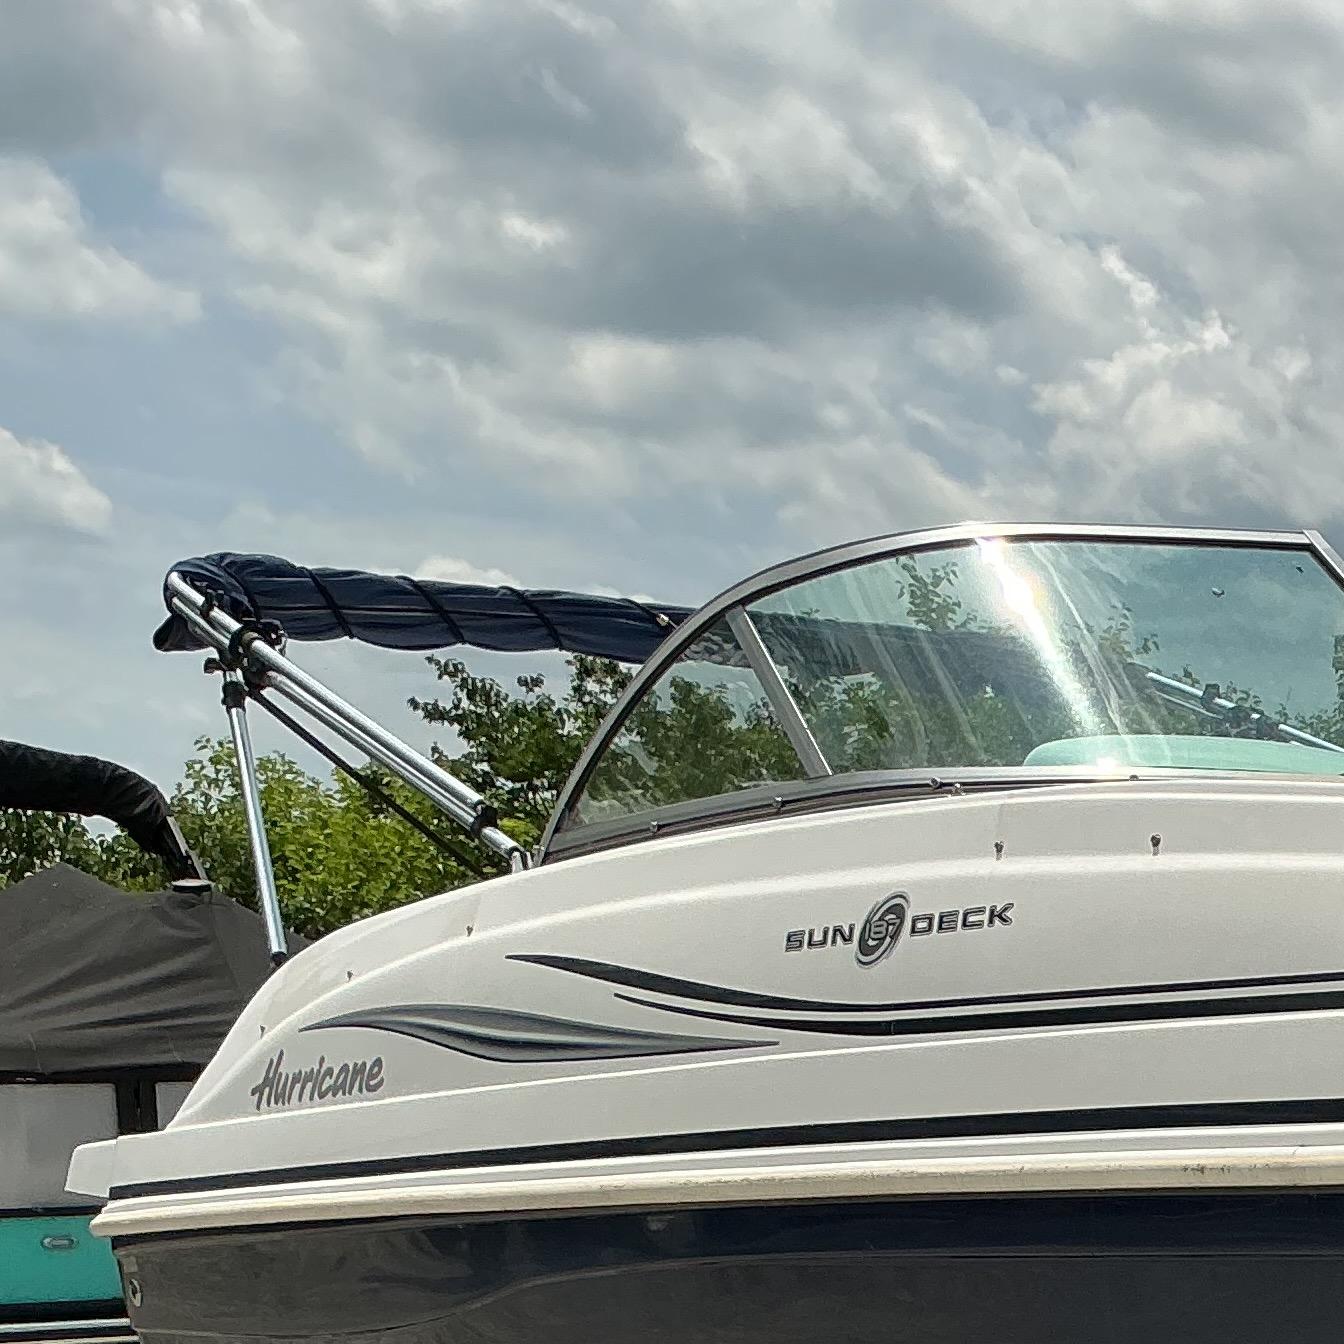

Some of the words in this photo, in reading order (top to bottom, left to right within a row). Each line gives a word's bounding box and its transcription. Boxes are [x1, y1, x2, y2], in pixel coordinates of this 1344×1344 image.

[785, 923, 856, 952] SUN
[865, 915, 902, 941] 187
[910, 903, 1015, 937] DECK
[250, 1048, 385, 1112] Hurricane
